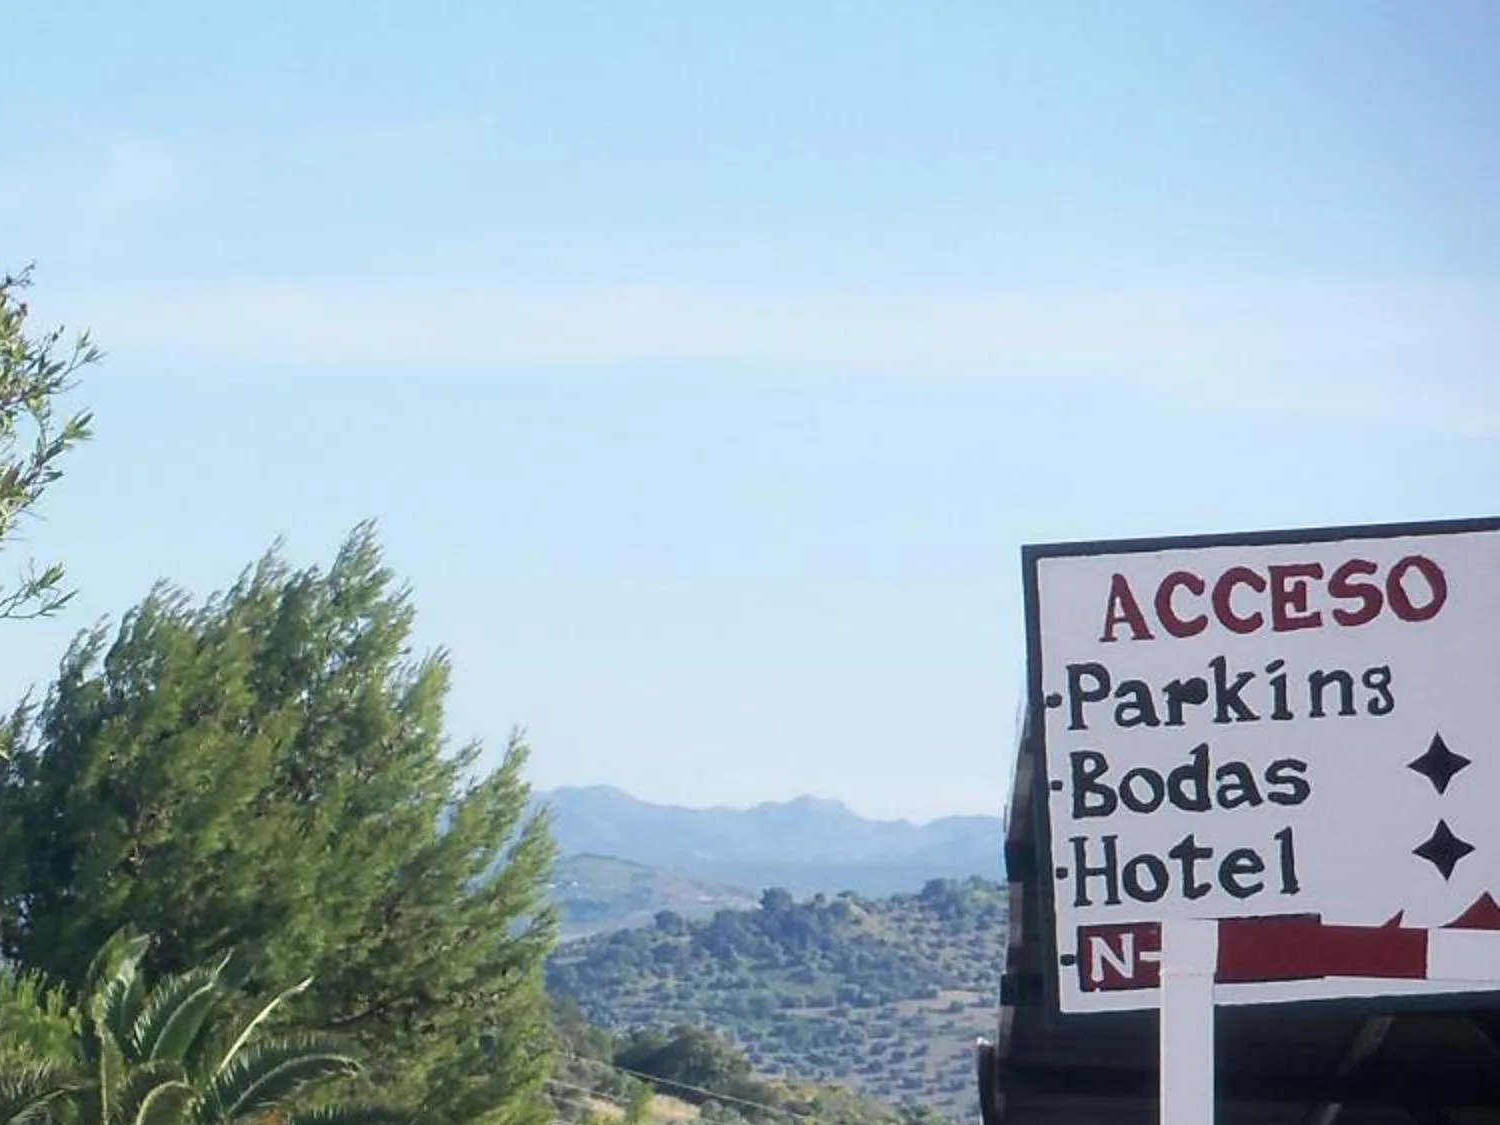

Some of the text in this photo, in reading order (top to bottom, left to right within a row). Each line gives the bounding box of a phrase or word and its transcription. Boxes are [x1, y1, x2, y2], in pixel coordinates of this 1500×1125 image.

[1099, 555, 1448, 642] ACCESO
[1067, 656, 1395, 730] Parking
[1069, 743, 1311, 819] Bodas
[1069, 826, 1301, 907] Hotel
